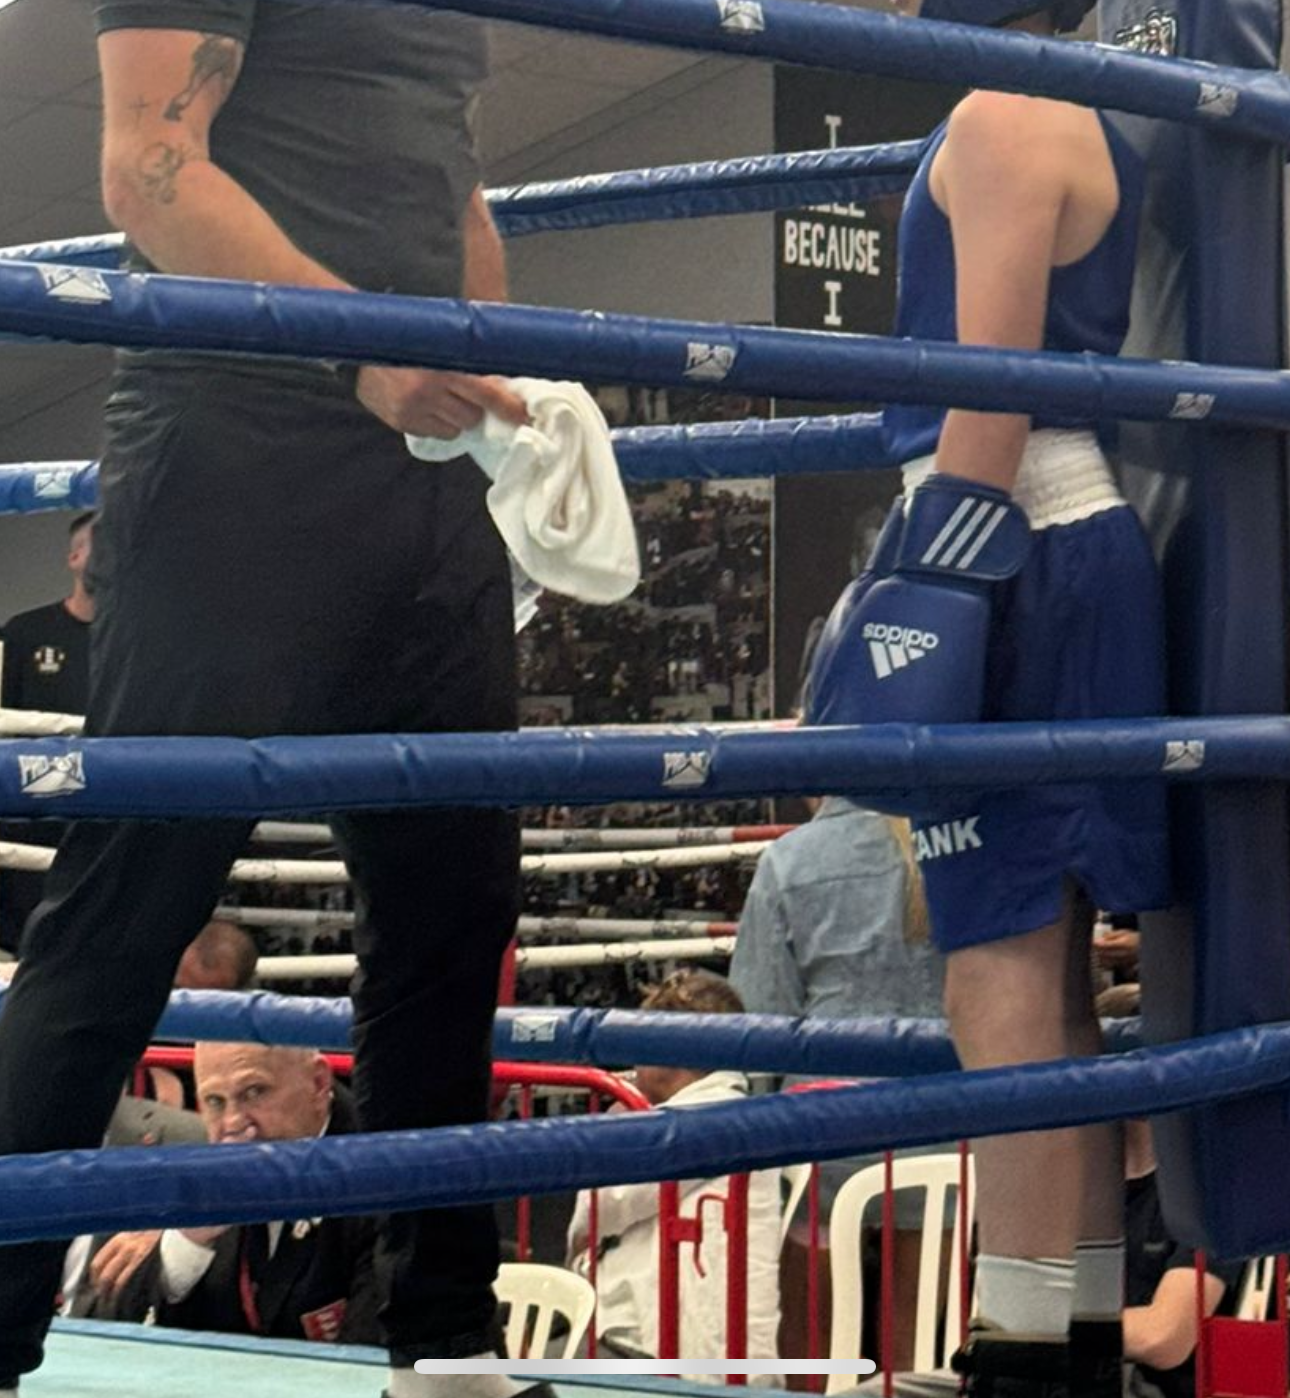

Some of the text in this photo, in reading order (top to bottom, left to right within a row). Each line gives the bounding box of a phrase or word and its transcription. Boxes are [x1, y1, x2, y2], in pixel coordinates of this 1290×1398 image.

[784, 219, 880, 276] BECAUSE
[823, 280, 842, 326] I
[862, 622, 939, 650] adidas
[911, 815, 983, 862] ANK
